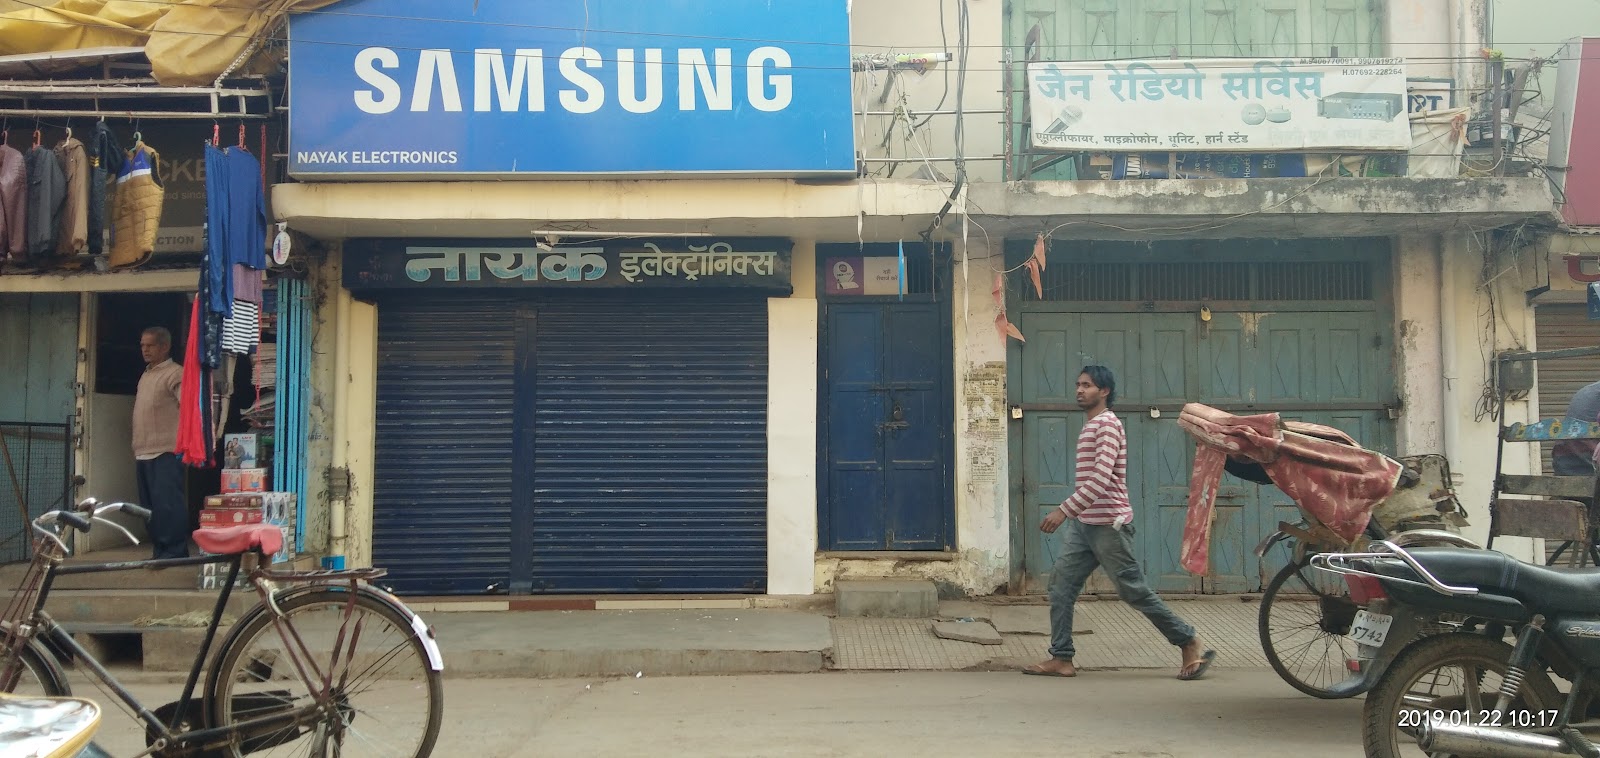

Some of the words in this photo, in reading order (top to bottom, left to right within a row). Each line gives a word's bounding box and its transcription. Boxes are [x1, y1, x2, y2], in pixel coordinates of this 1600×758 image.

[354, 46, 793, 114] SAMSUNG
[1035, 62, 1093, 101] जैन
[1104, 62, 1206, 102] रेडियो
[1221, 60, 1324, 100] सर्विस
[297, 151, 348, 164] NAYAK
[352, 151, 457, 164] ELECTRONICS
[405, 247, 608, 282] नायक
[619, 242, 778, 283] इलेक्ट्रॉनिक्स
